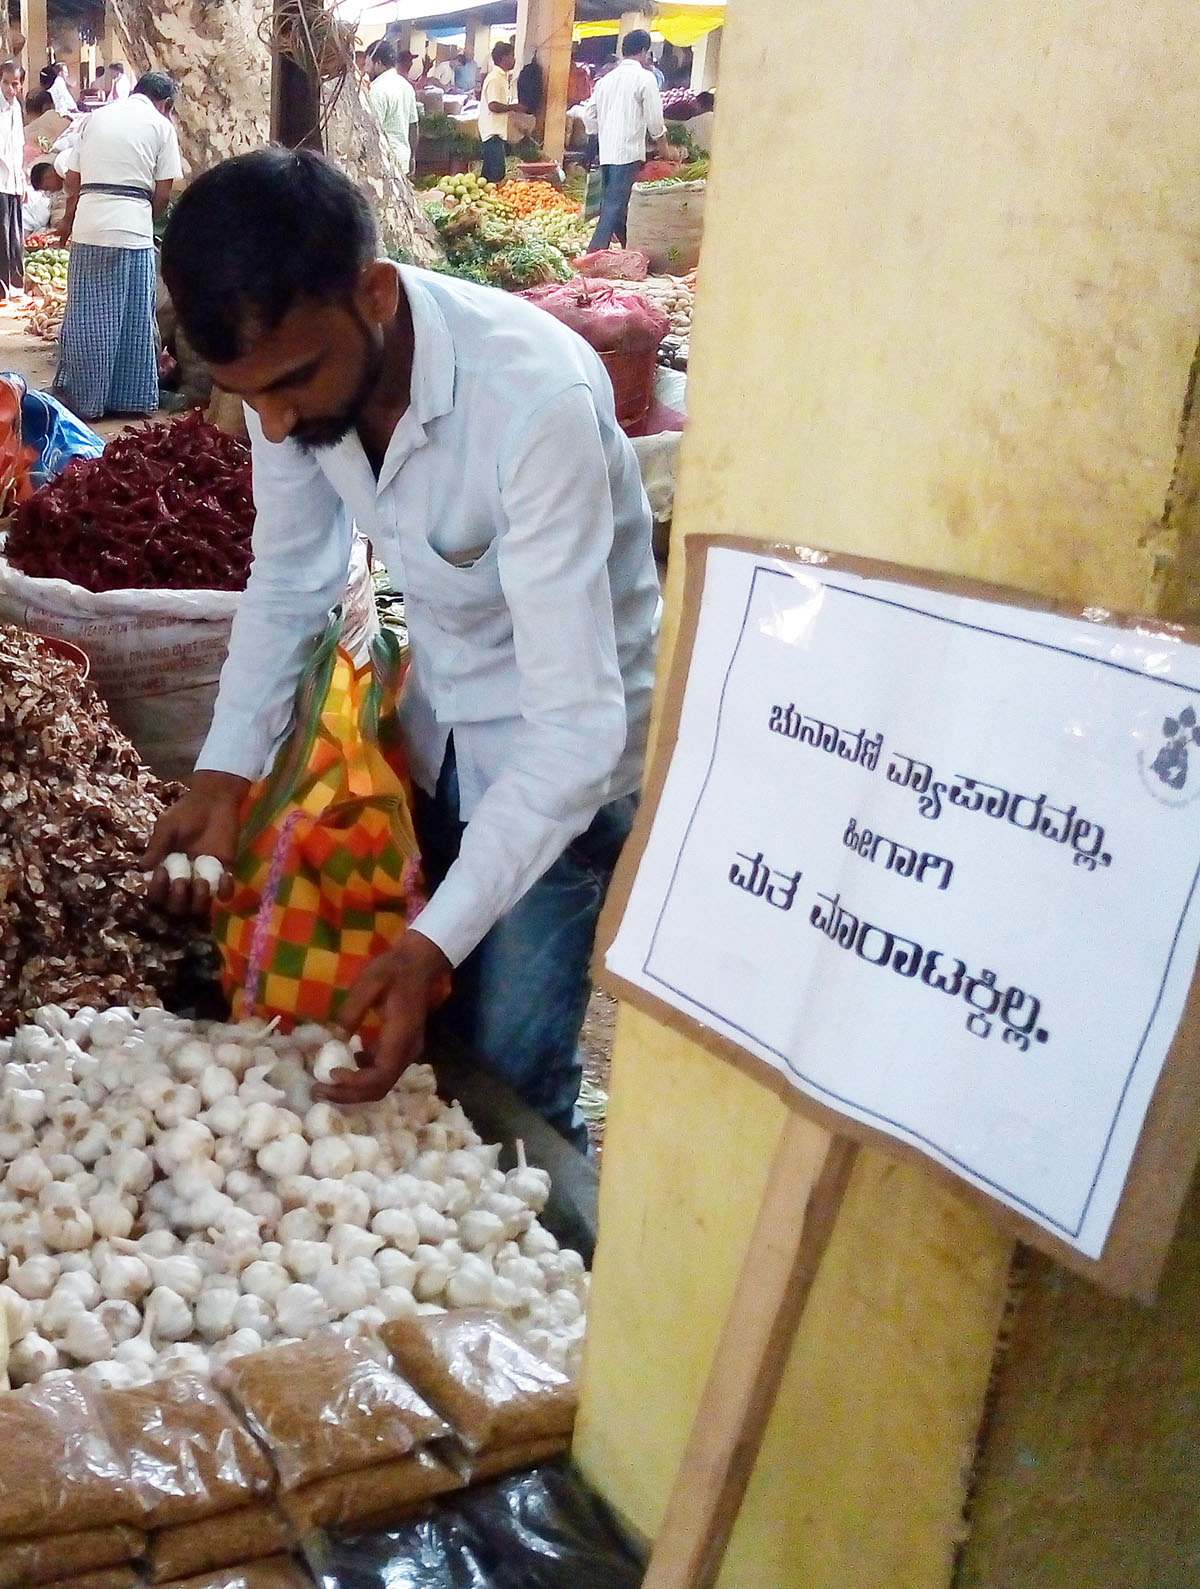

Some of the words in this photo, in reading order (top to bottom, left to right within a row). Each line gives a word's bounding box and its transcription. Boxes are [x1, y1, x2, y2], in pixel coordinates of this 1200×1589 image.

[842, 816, 955, 890] ಹೀಗಾಗಿ
[886, 751, 1112, 872] ವ್ಯಾಪಾರವಲ್ಲ,
[728, 851, 803, 911] ಮತ
[809, 891, 1049, 1052] ಮಾರಾಟಕ್ಕಿಲ್ಲ.
